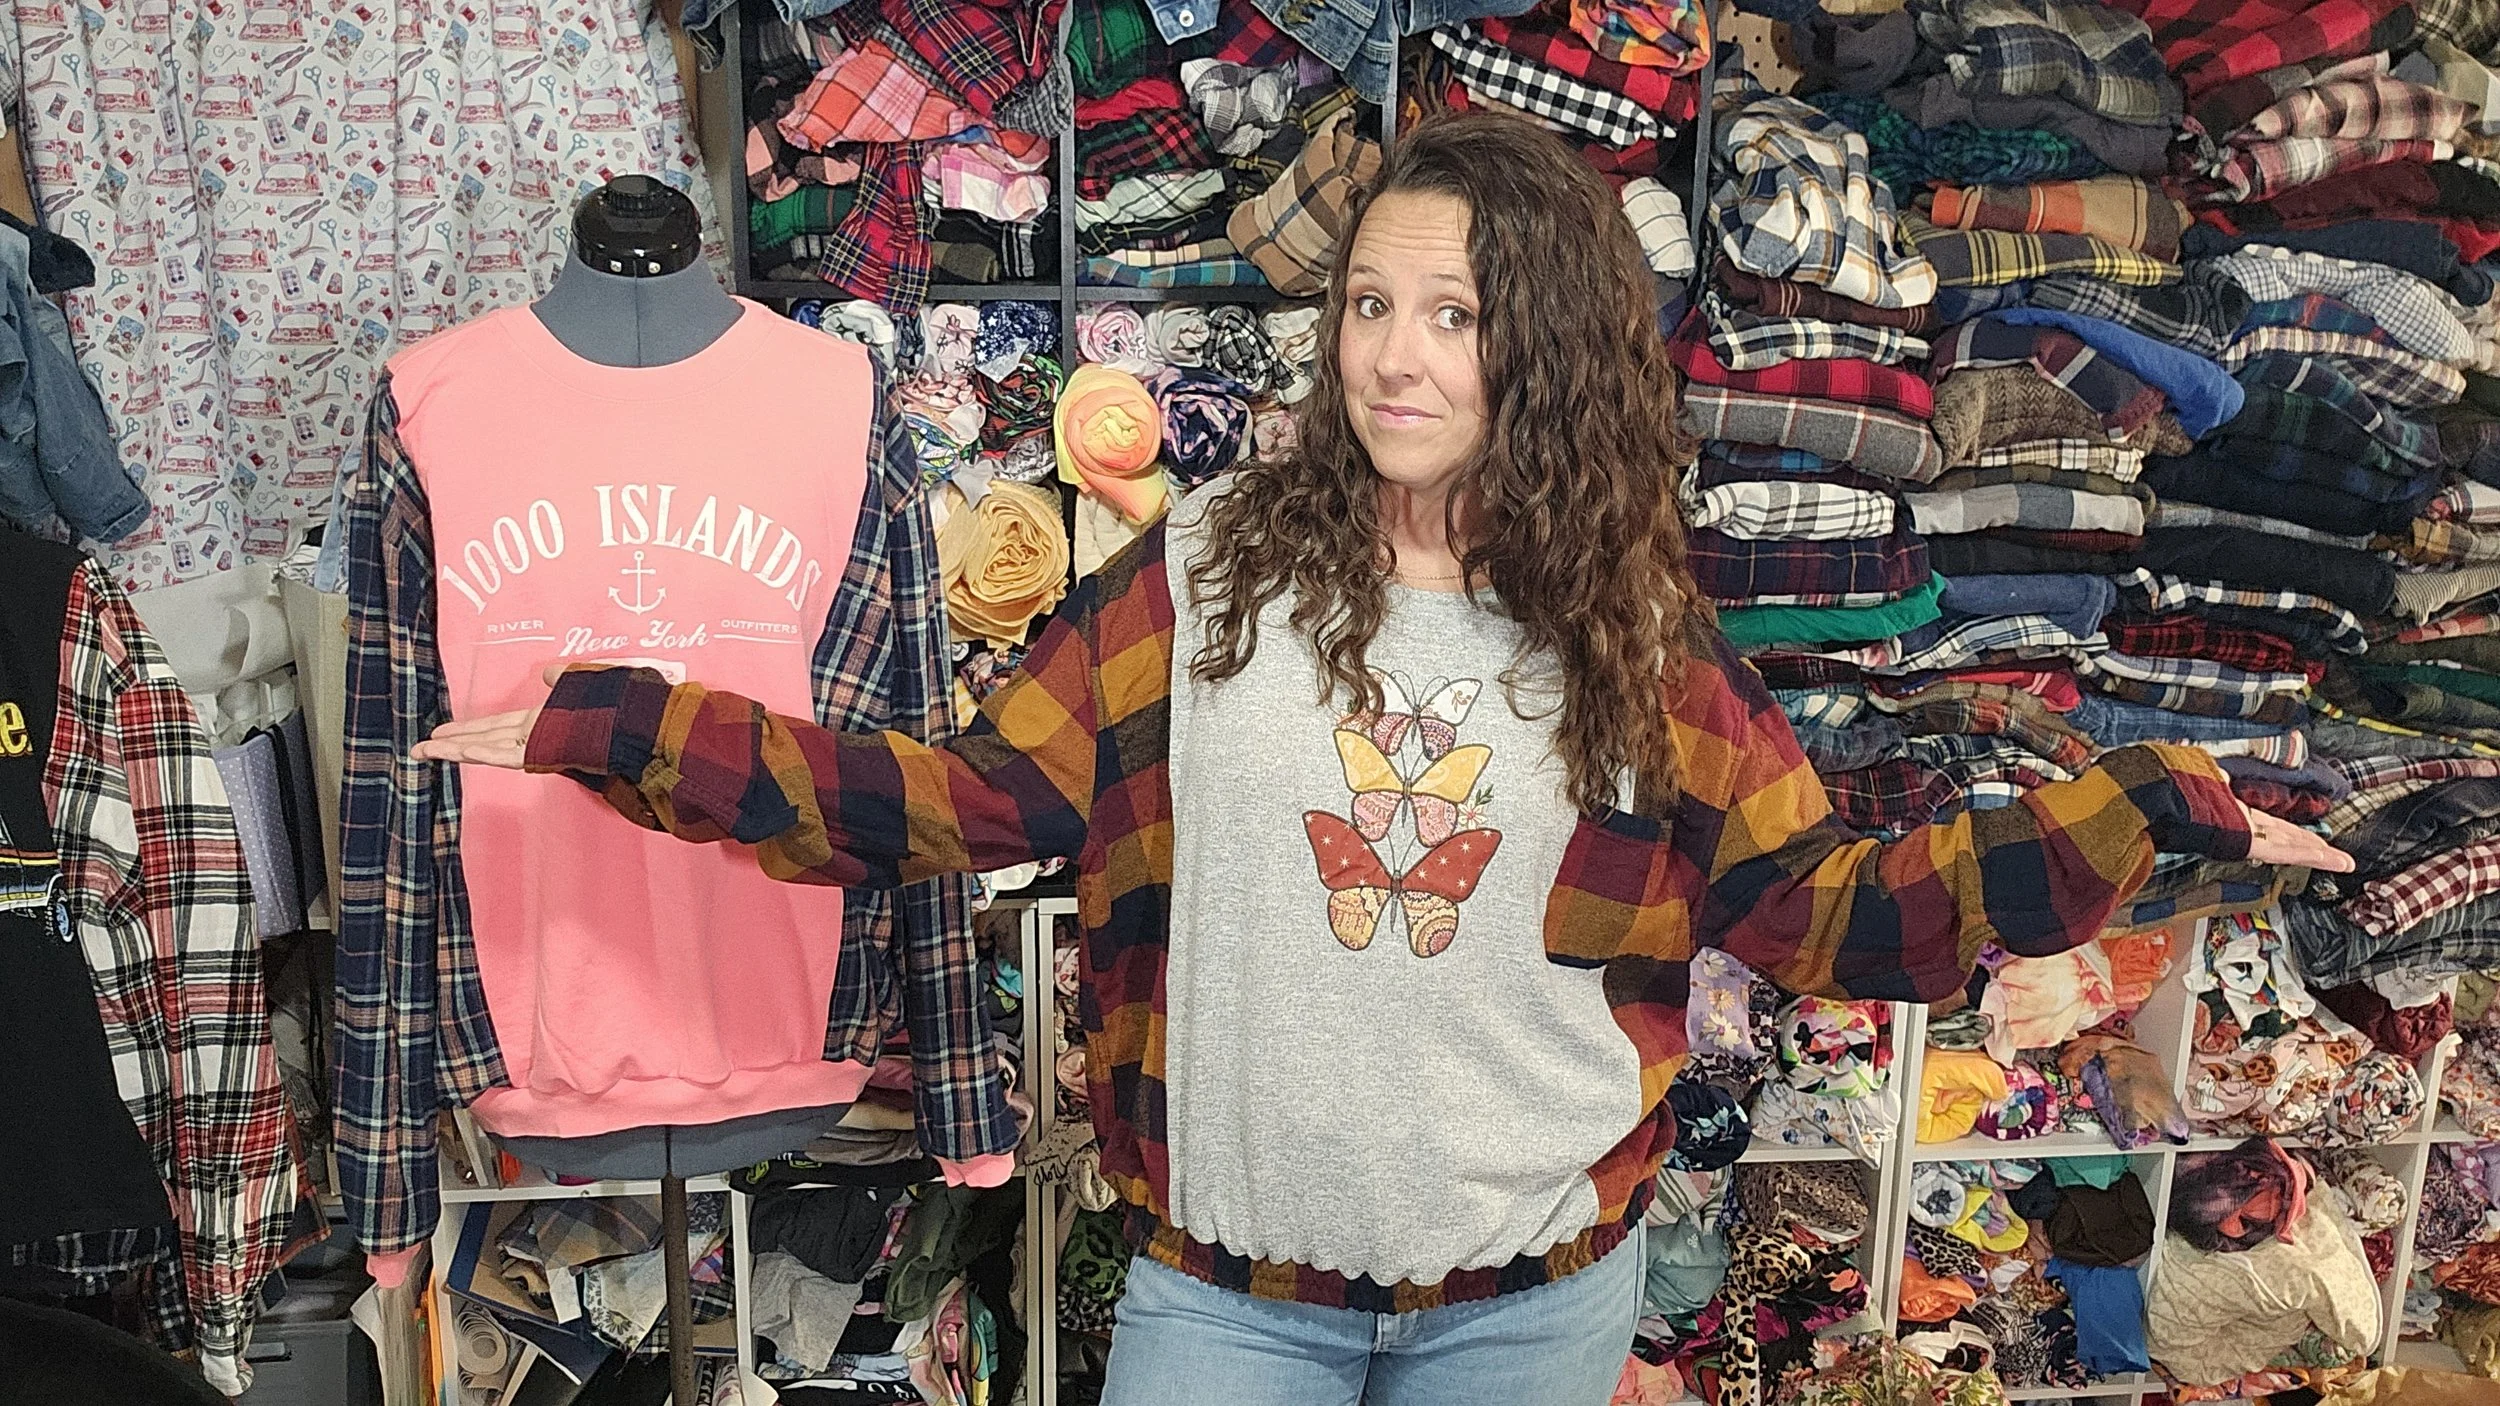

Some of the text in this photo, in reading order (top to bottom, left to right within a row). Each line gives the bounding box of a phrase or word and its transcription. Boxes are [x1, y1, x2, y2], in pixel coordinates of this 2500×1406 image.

[441, 483, 822, 615] 1000 ISLANDS
[487, 619, 545, 634] RIVER
[559, 620, 709, 657] New York
[720, 619, 799, 634] OUTFITTERS
[0, 701, 33, 756] e
